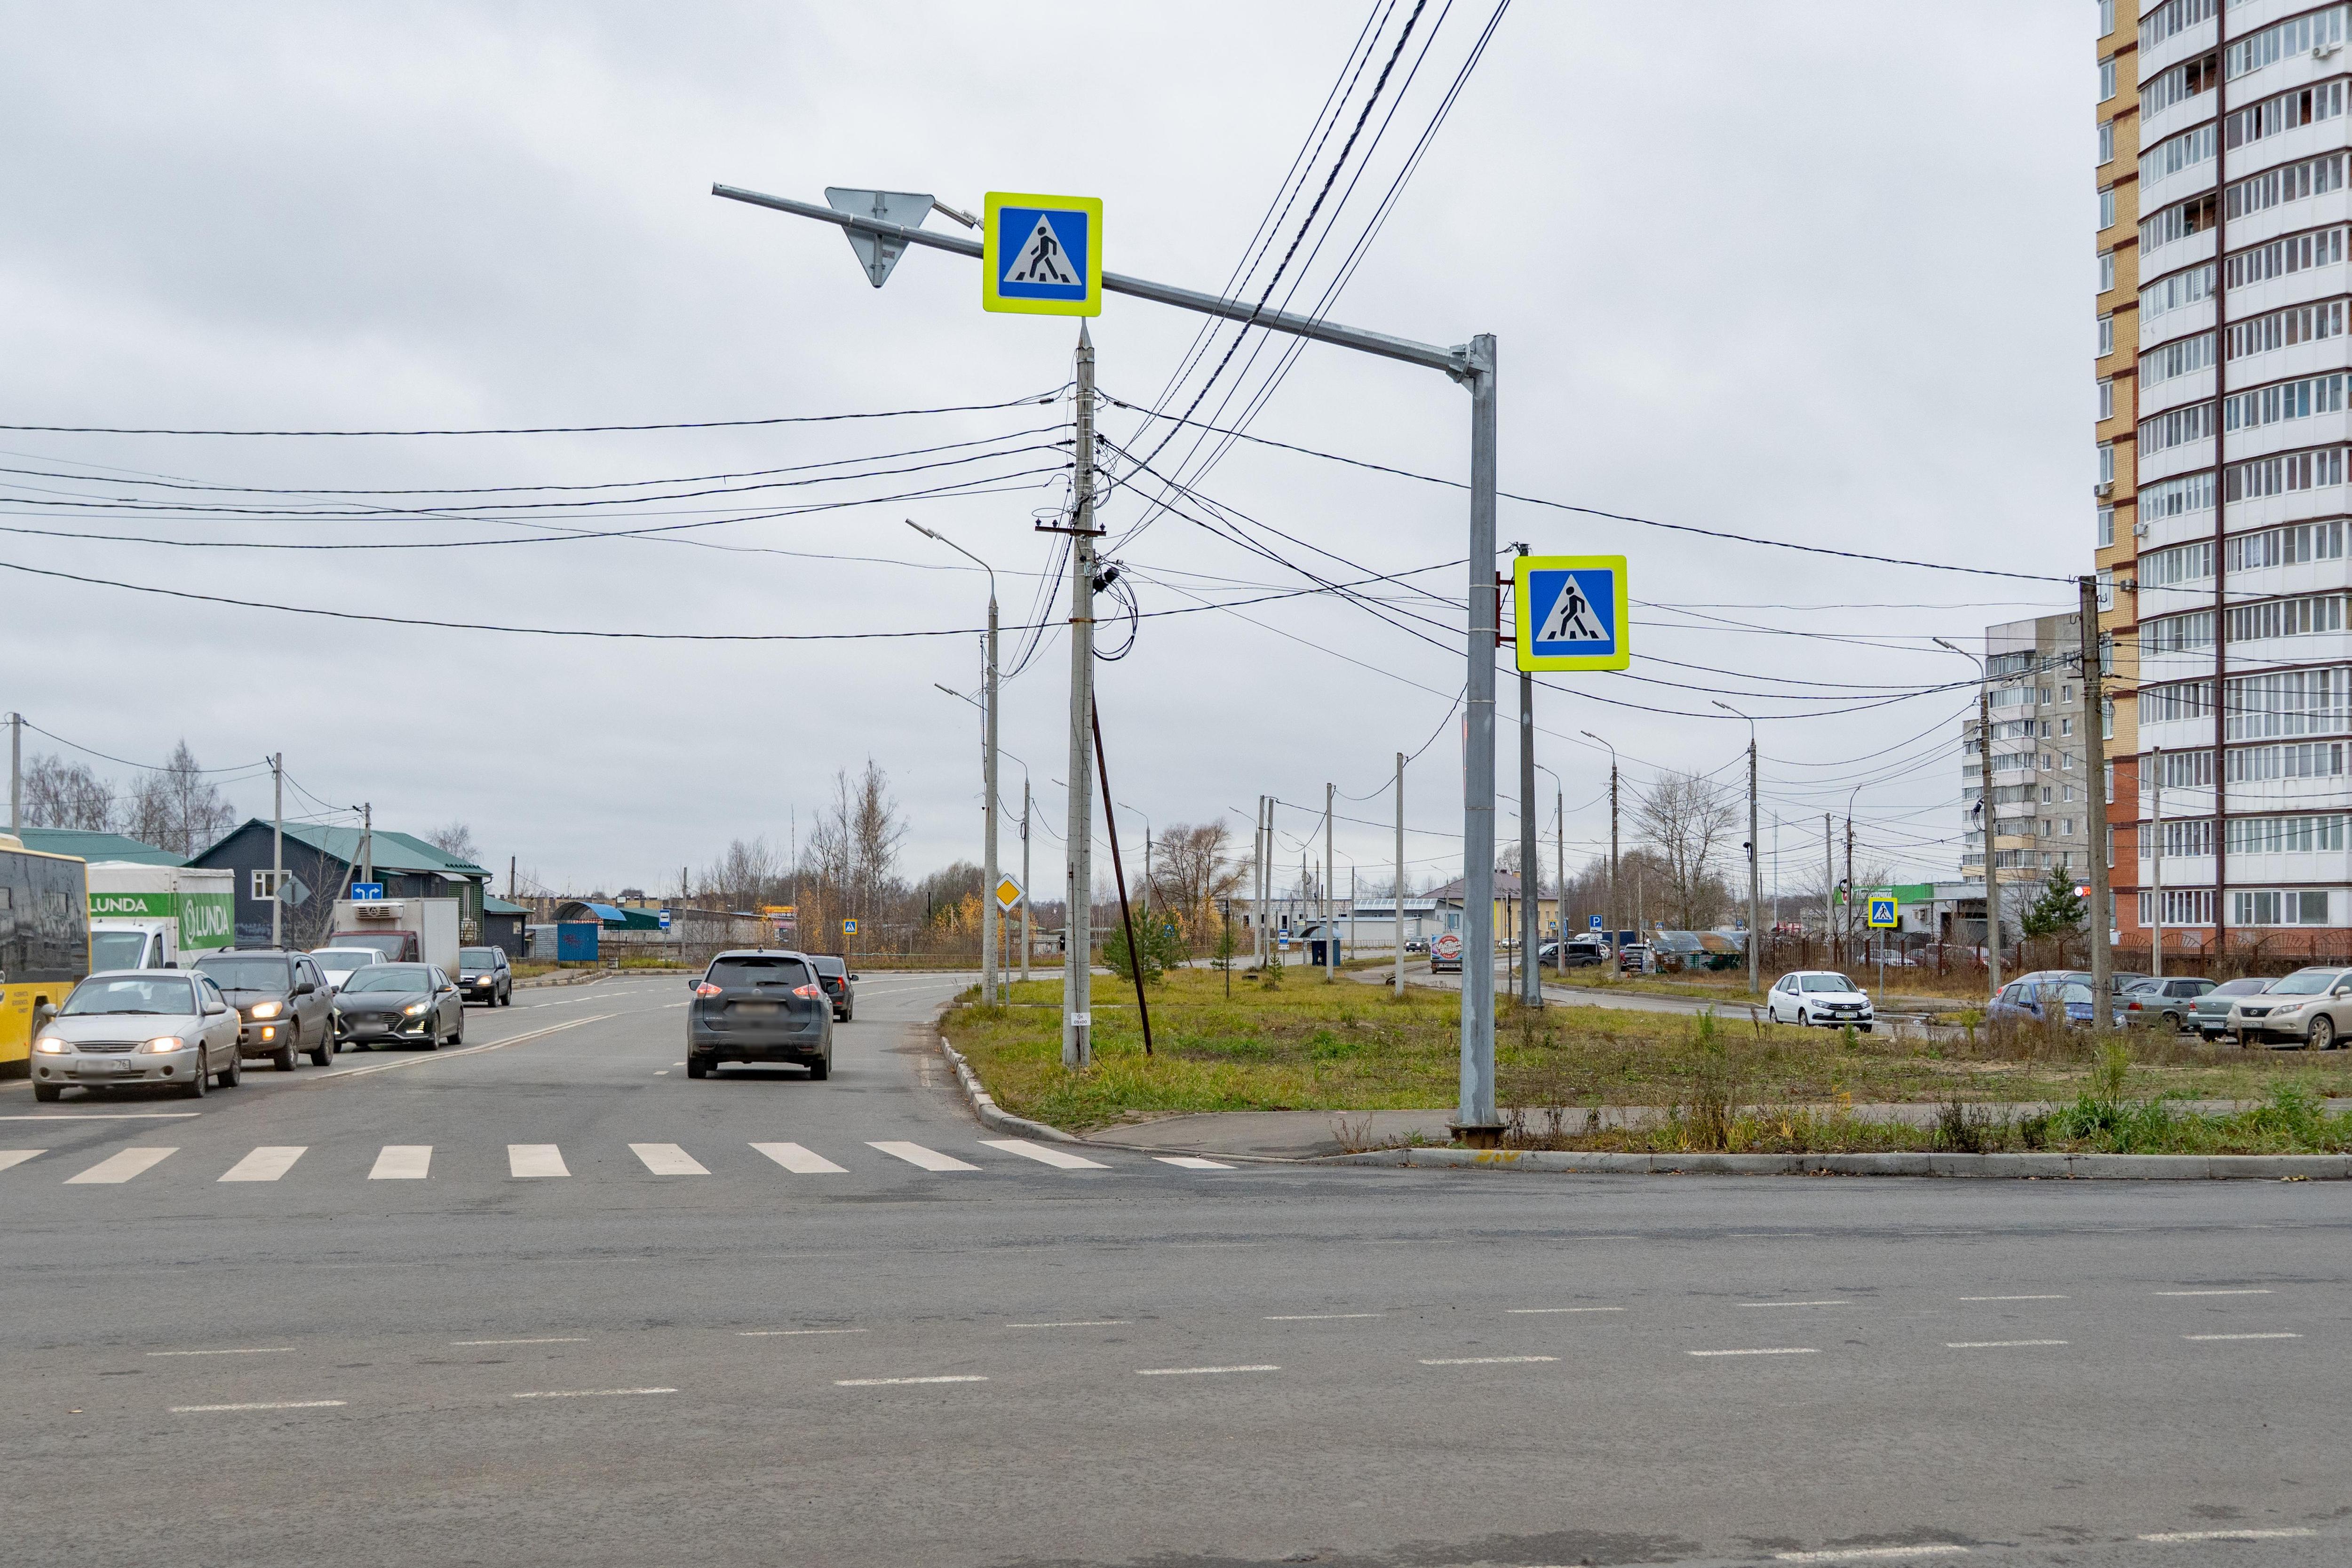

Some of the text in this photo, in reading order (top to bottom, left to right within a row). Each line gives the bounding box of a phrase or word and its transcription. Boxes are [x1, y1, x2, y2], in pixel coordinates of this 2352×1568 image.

[90, 898, 148, 912] LUNDA
[196, 905, 230, 937] LUNDA
[1593, 917, 1600, 926] P
